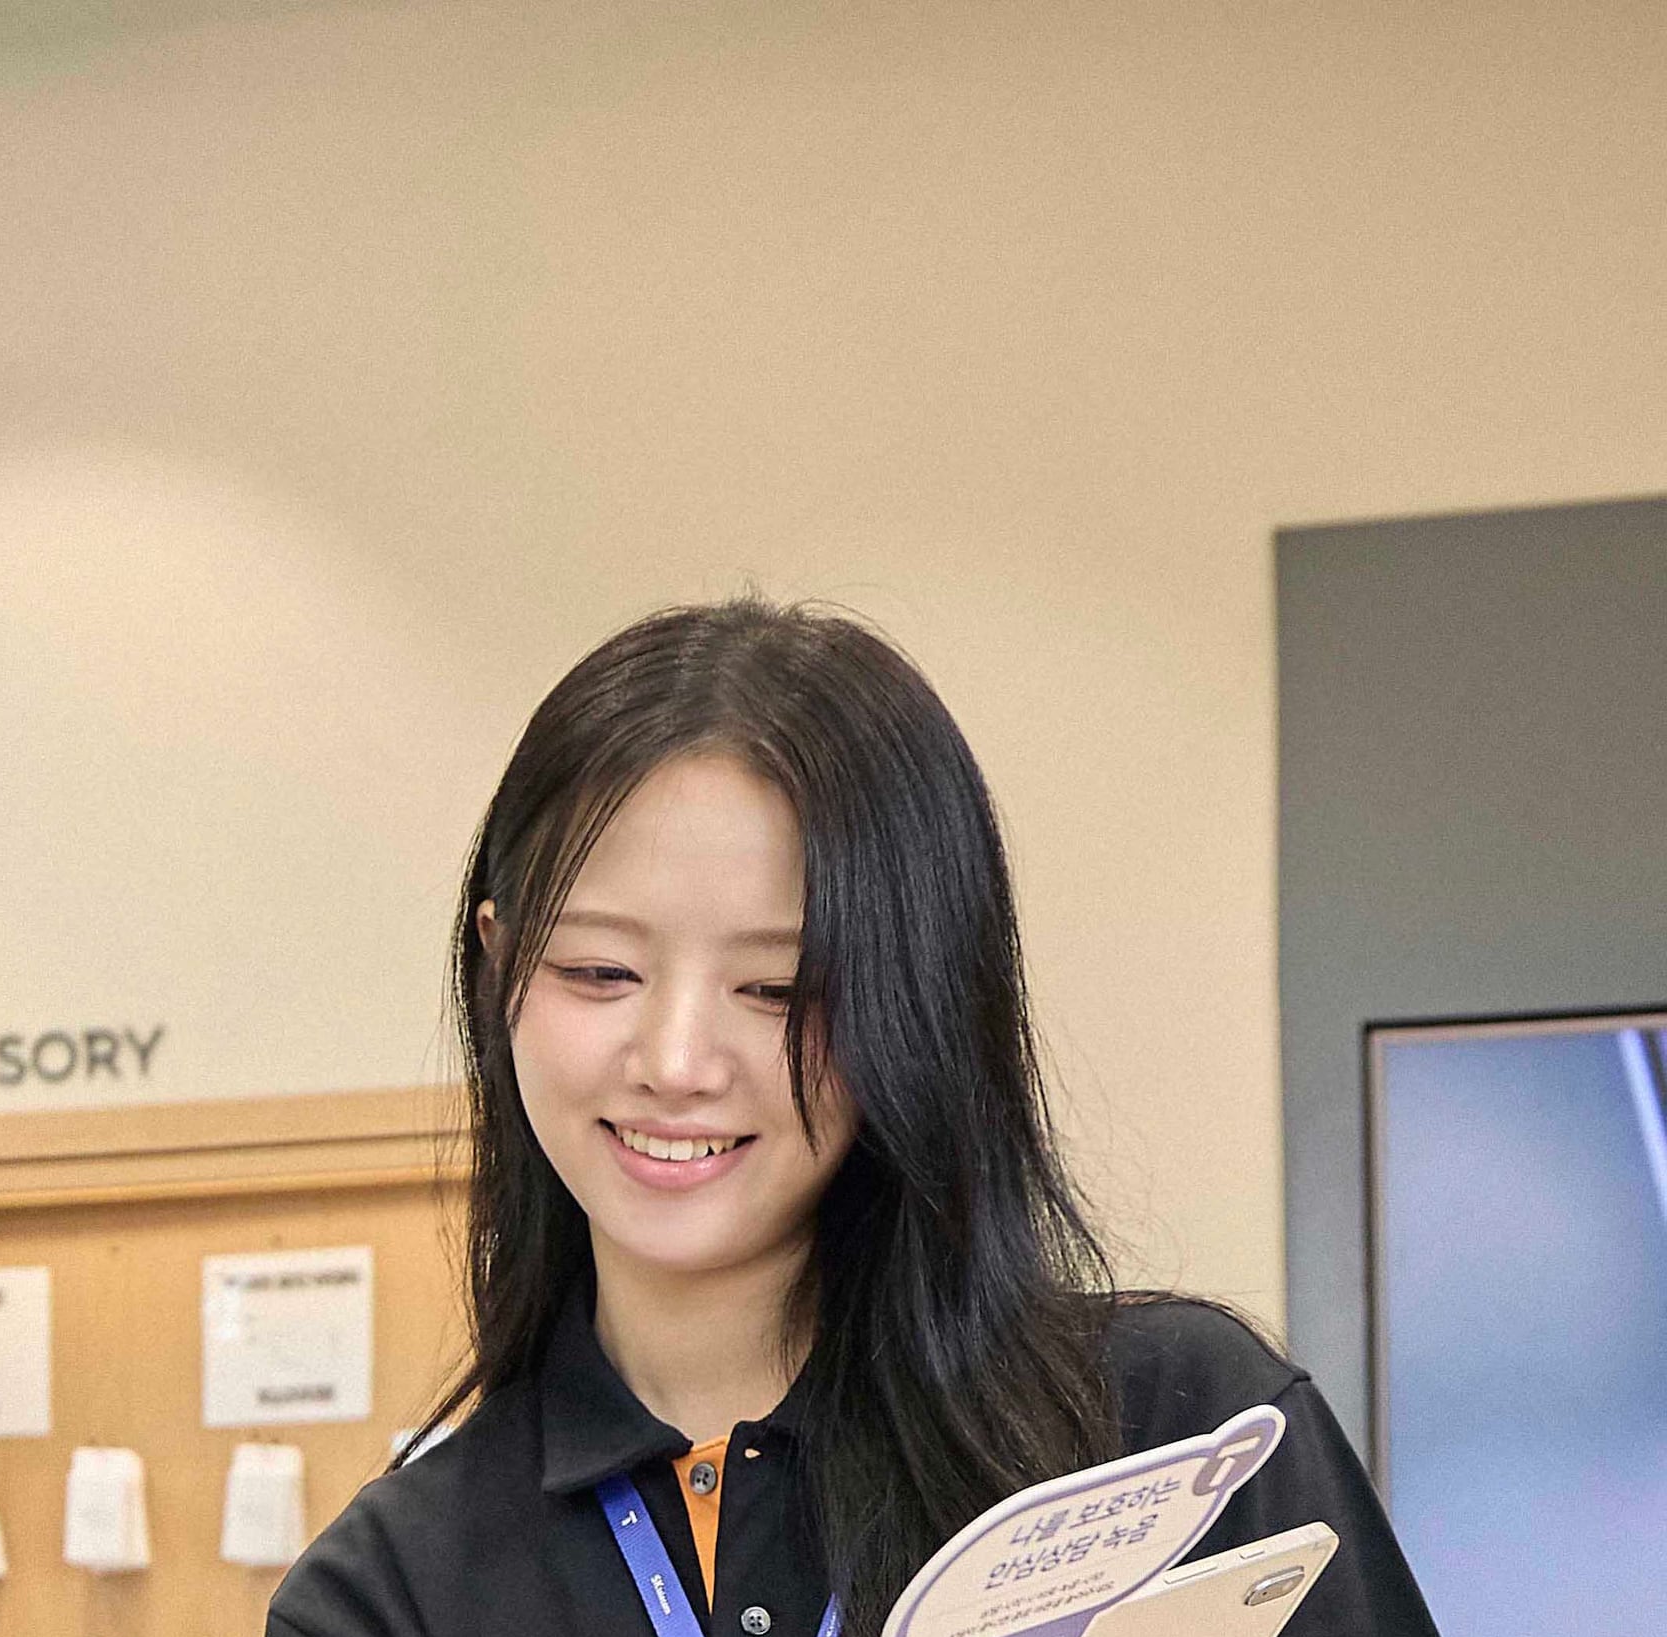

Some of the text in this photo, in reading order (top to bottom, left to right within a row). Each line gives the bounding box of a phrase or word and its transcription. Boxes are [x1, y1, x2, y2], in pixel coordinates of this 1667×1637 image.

[1010, 1478, 1181, 1546] 나를 보호하는
[985, 1514, 1158, 1590] 안심상담 녹음
